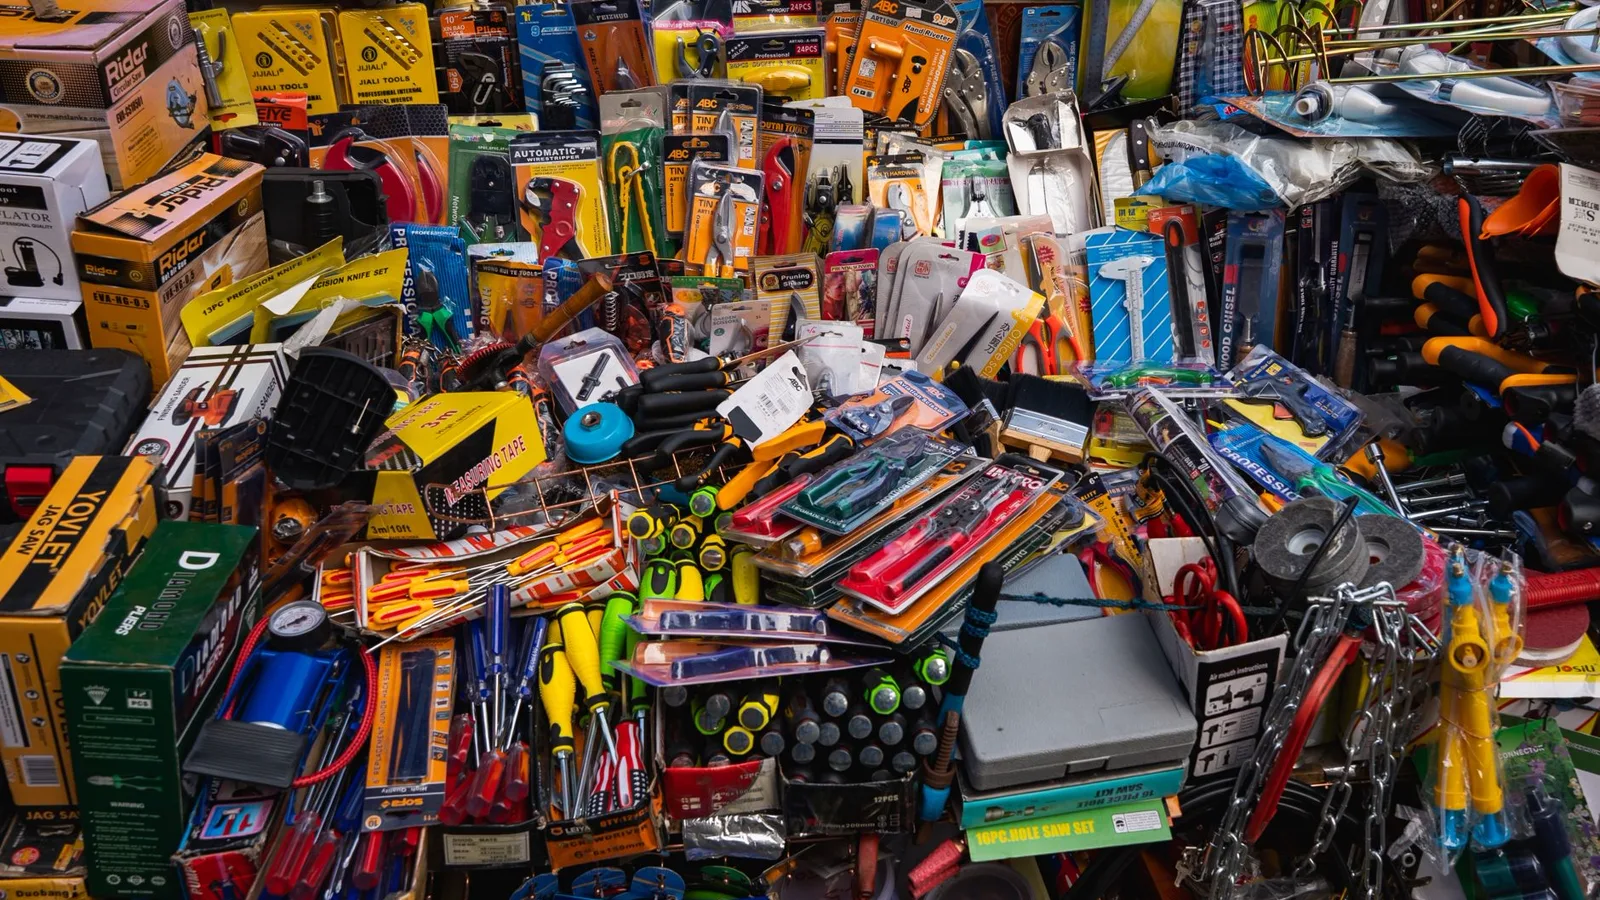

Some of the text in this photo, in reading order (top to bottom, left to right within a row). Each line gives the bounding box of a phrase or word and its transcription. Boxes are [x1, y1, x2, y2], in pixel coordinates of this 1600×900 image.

[790, 3, 812, 11] 24PCS
[873, 0, 898, 13] ABC
[834, 16, 853, 24] Hand
[477, 25, 507, 34] Pliers
[904, 24, 951, 42] Hand Riveter
[796, 46, 818, 54] 24PCS
[359, 75, 411, 86] JIALI TOOLS
[255, 82, 309, 92] JIALI TOOLS
[696, 99, 718, 109] ABC
[696, 117, 711, 125] TIN
[514, 147, 577, 158] AUTOMATIC
[526, 154, 580, 163] WIRESTRIPPER
[668, 150, 689, 159] ABC
[669, 167, 684, 175] TIN
[31, 222, 53, 230] QUALITY
[1331, 240, 1339, 276] GUARANTEE
[347, 270, 371, 282] KNIFE
[373, 266, 389, 277] SET
[781, 271, 811, 282] Pruning
[202, 250, 323, 317] 13PC PRECISION KNIFE SET
[1220, 286, 1236, 372] WOOD CHISEL
[787, 376, 803, 392] ABC
[896, 379, 923, 401] Aviation
[924, 385, 947, 401] ABC
[421, 408, 458, 429] 3m
[443, 449, 503, 507] MEASURING
[500, 434, 527, 463] TAPE
[388, 502, 416, 515] TAPE
[16, 504, 62, 556] JAG SAW
[32, 489, 107, 570] YOVLET
[371, 524, 412, 535] 3m/10ft
[78, 559, 124, 630] YOVLET
[115, 604, 147, 636] PLIERS
[1208, 662, 1269, 682] Air mouth instructions
[373, 726, 385, 776] REPLACEMENT
[379, 700, 387, 725] JUNIOR
[381, 785, 428, 795] High Quality
[1094, 782, 1144, 798] SAW KIT
[1112, 792, 1140, 803] PIECE
[109, 801, 145, 809] WARNING
[26, 811, 52, 820] JAG
[1042, 823, 1072, 838] SAW
[1073, 819, 1096, 833] SET
[16, 888, 70, 899] Duobang
